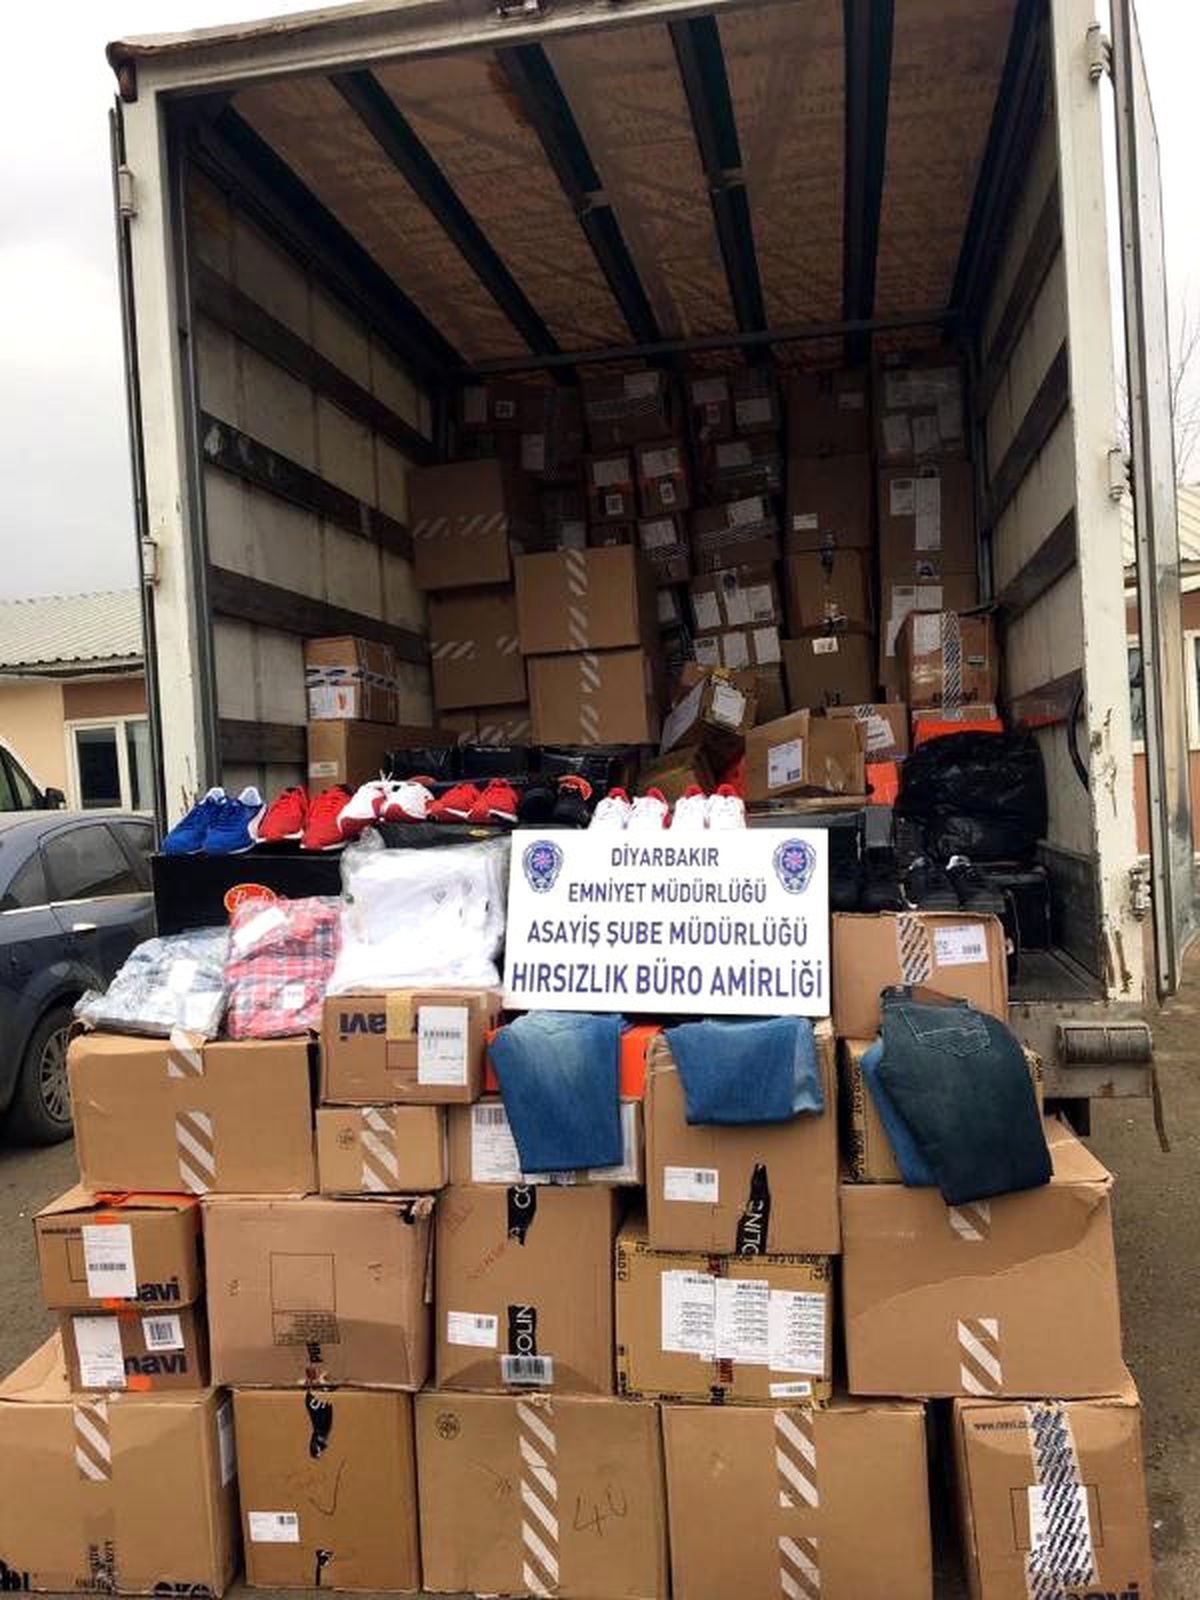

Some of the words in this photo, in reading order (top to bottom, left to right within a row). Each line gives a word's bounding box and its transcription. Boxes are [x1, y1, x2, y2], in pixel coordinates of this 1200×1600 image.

[610, 843, 719, 867] DİYARBAKIR
[568, 878, 647, 903] EMNİYET
[651, 877, 767, 903] MÜDÜRLÜĞÜ
[527, 915, 600, 948] ASAYİŞ
[606, 921, 663, 949] ŞUBE
[669, 915, 808, 946] MÜDÜRLÜĞÜ
[511, 963, 629, 993] HIRSIZLIK
[636, 957, 702, 996] BÜRO
[710, 960, 823, 999] AMİRLİĞİ
[515, 1305, 534, 1358] OLIN
